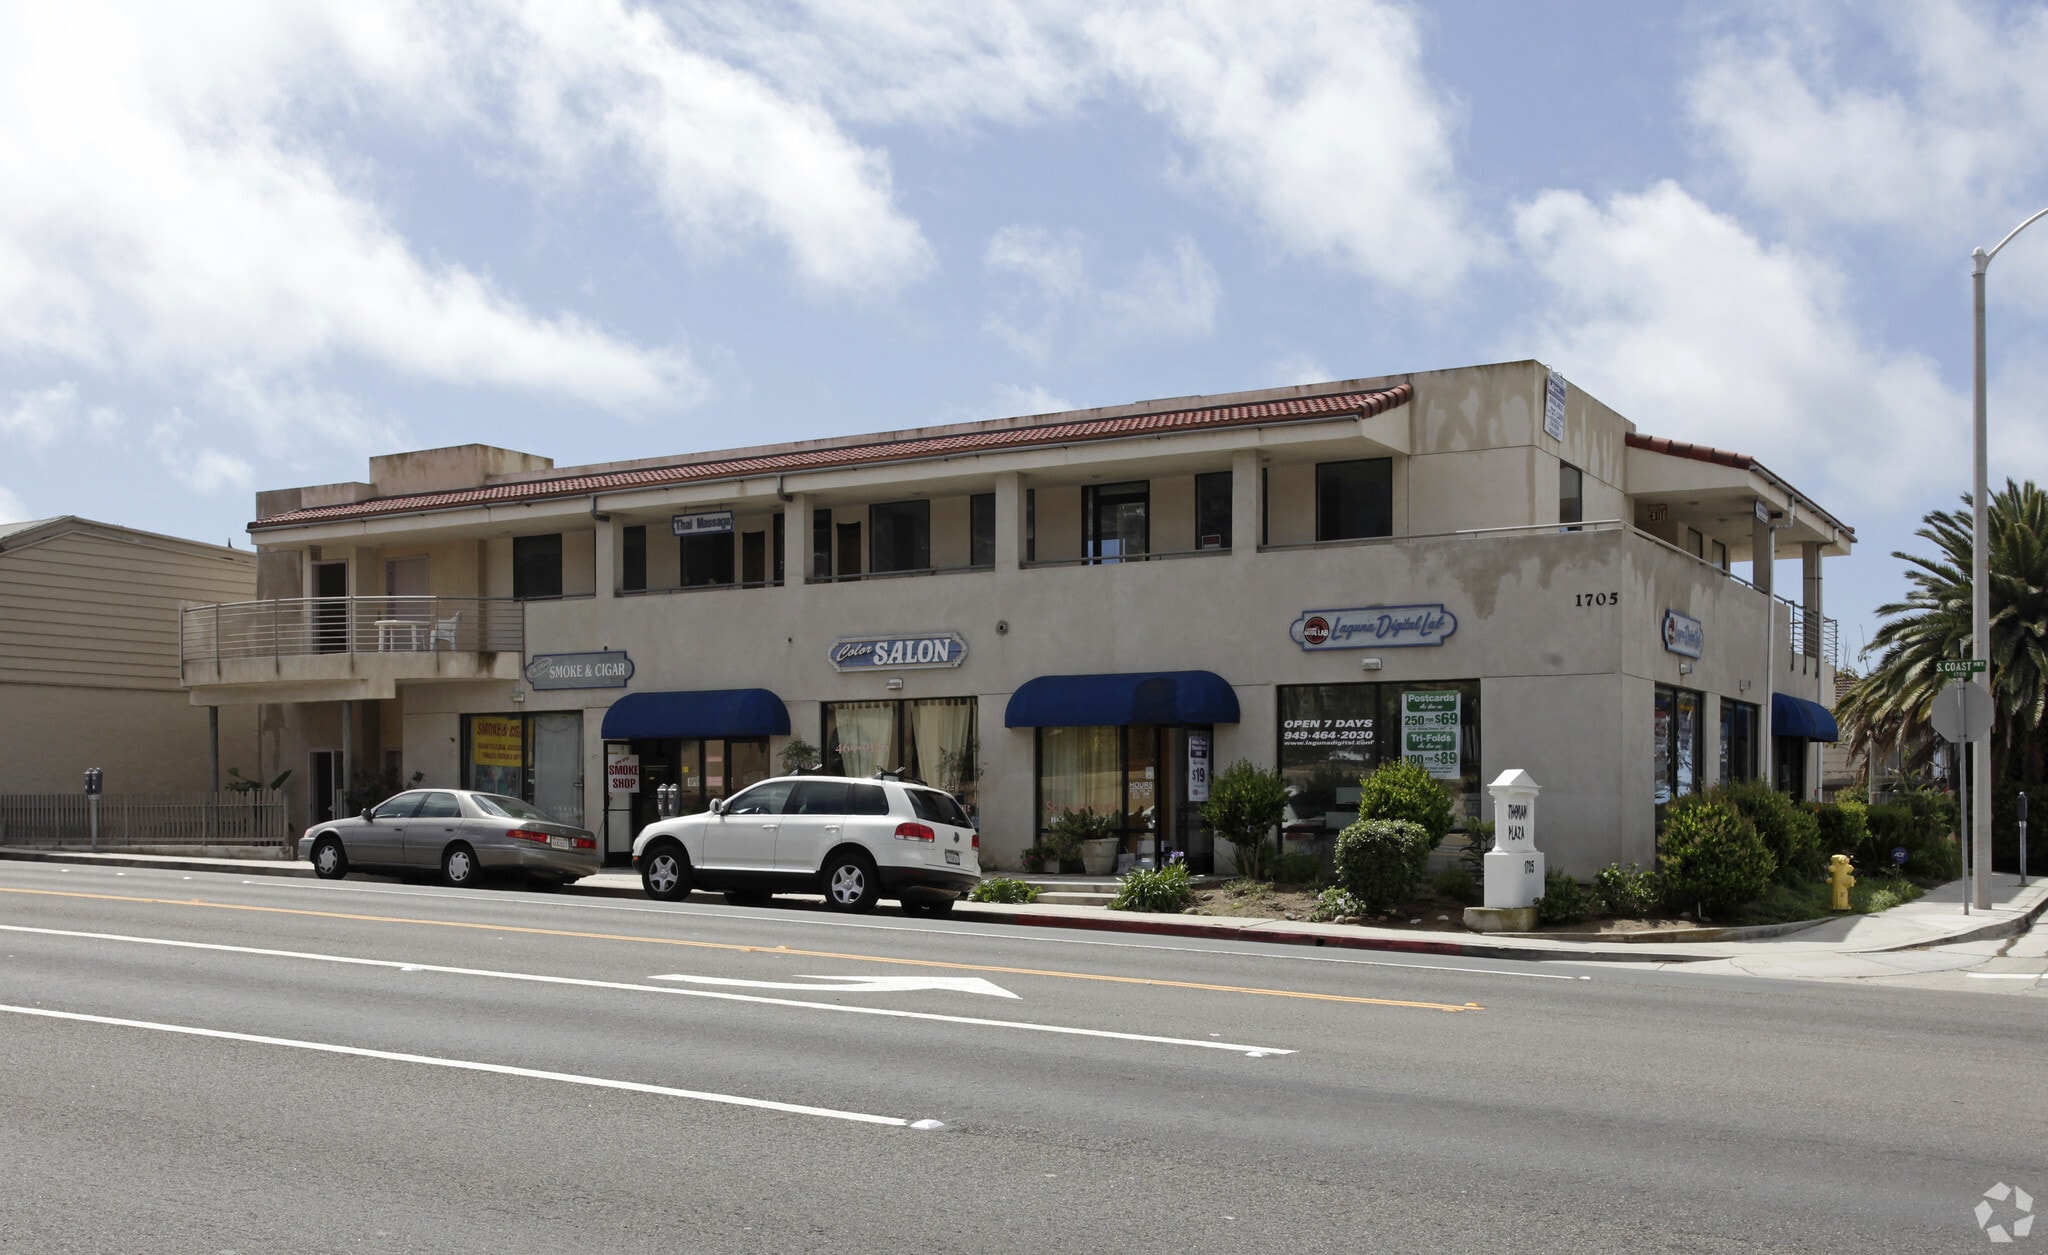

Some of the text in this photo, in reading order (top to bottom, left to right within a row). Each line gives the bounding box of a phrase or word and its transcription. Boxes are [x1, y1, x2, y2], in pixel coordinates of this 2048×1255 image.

[675, 517, 731, 531] Thai Massage
[1575, 592, 1618, 607] 1705
[1331, 612, 1445, 640] Laguna Digital Lab
[1318, 629, 1328, 637] LAB
[836, 639, 951, 665] Color SALON
[549, 664, 584, 679] SMOKE
[585, 665, 593, 677] &
[595, 663, 626, 676] CIGAR
[1936, 662, 1943, 672] S.
[1944, 662, 1972, 672] COAST
[1408, 694, 1455, 702] Postcards
[1284, 719, 1321, 728] OPEN
[1335, 719, 1373, 728] DAYS
[1404, 715, 1424, 726] 250
[1434, 713, 1458, 725] $69
[1411, 734, 1451, 742] Tri-Folds
[1433, 752, 1457, 764] $89
[609, 765, 639, 775] SMOKE
[1192, 767, 1205, 782] $19
[612, 778, 636, 789] SHOP
[1129, 781, 1153, 789] HOURS
[1508, 825, 1525, 841] PLAZA
